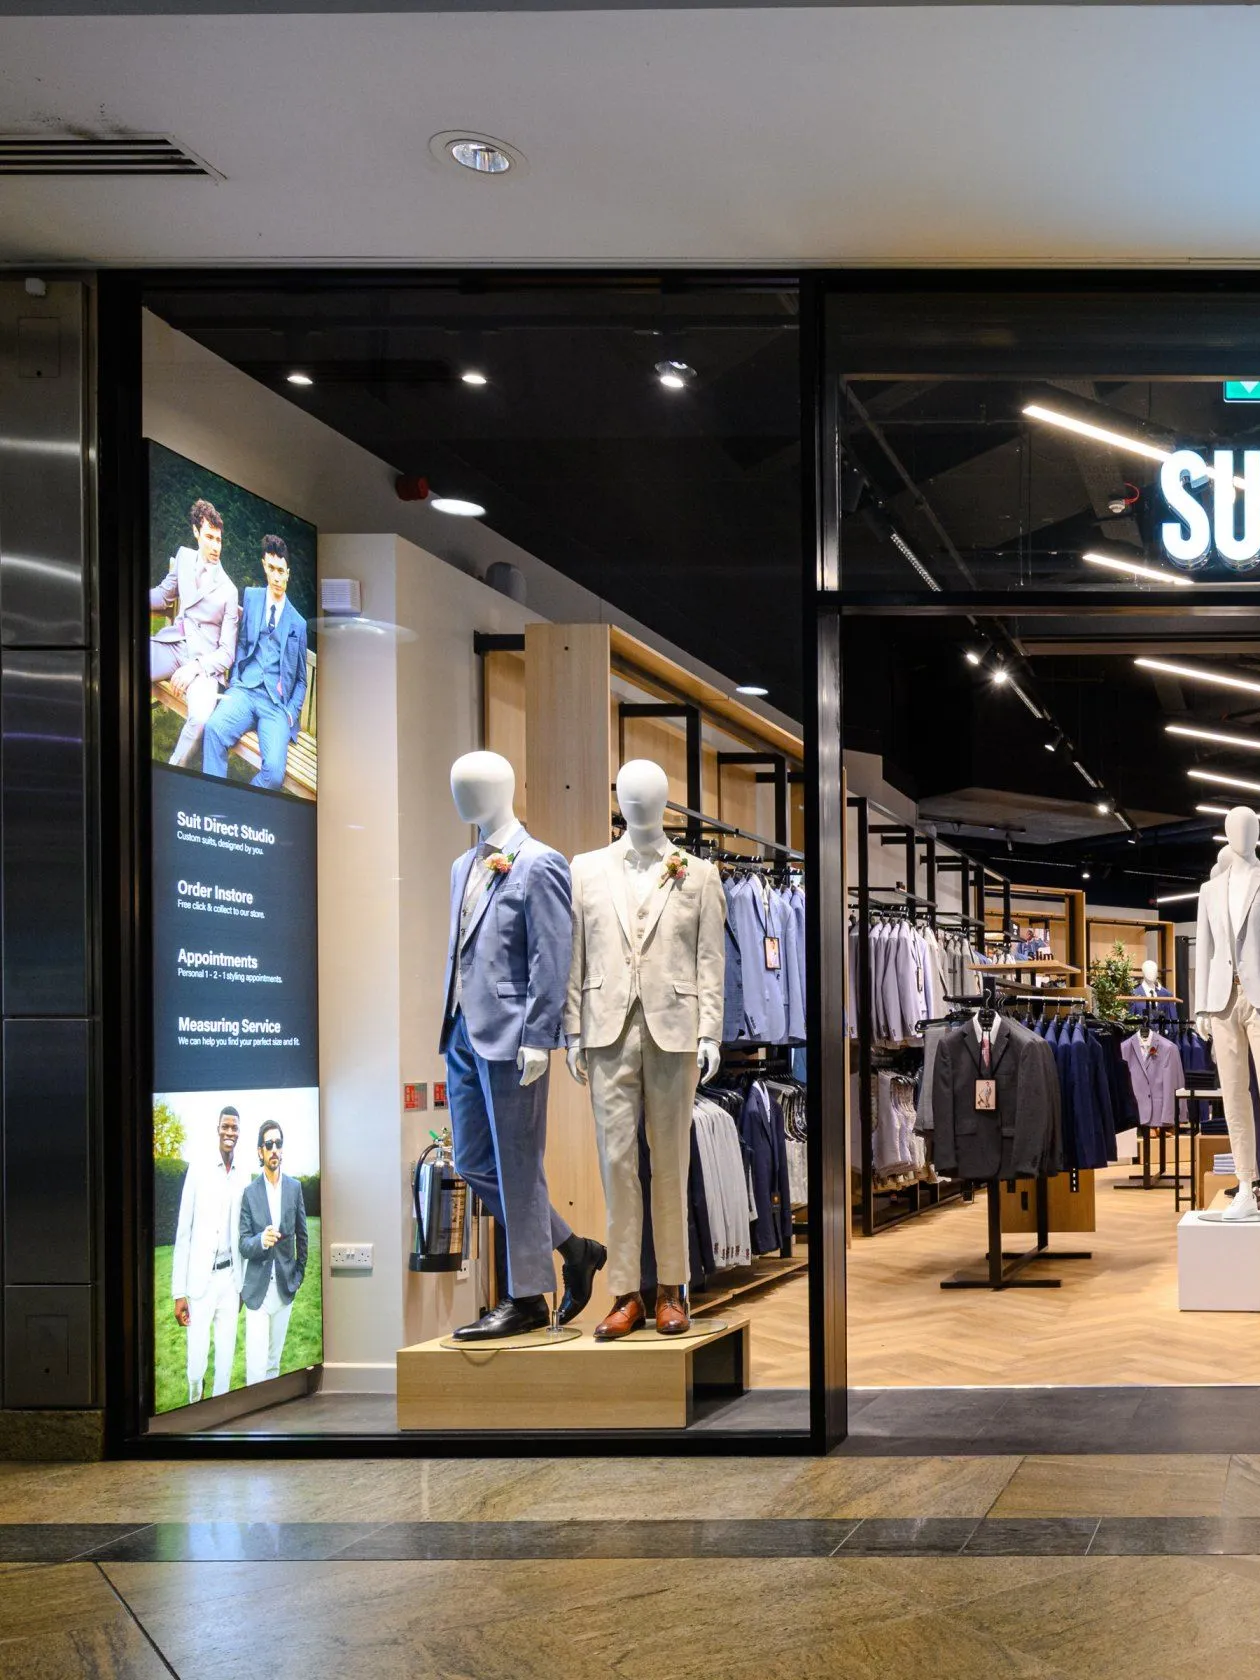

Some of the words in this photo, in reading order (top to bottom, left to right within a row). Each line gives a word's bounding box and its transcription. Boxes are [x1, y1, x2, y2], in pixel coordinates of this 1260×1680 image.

[177, 811, 202, 829] Suit
[203, 816, 239, 838] Direct
[240, 824, 275, 845] Studio
[177, 831, 201, 843] Custom
[201, 836, 218, 848] suits,
[218, 839, 244, 851] designed
[244, 843, 252, 855] by
[251, 847, 264, 856] you.
[177, 879, 212, 899] Order
[214, 884, 254, 905] Instore
[177, 899, 191, 909] Free
[192, 901, 206, 912] click
[206, 903, 213, 912] &
[213, 904, 232, 915] collect
[233, 907, 240, 916] to
[239, 909, 250, 917] our
[177, 948, 258, 969] Appointments
[177, 968, 205, 978] Personal
[226, 972, 245, 983] styling
[246, 973, 283, 984] appointments.
[178, 1016, 240, 1036] Measuring
[241, 1018, 281, 1034] Service
[178, 1036, 189, 1046] We
[189, 1038, 201, 1046] can
[202, 1037, 215, 1047] help
[215, 1038, 227, 1047] you
[227, 1037, 239, 1046] find
[239, 1038, 253, 1048] your
[252, 1037, 272, 1047] perfect
[272, 1037, 282, 1046] size
[282, 1037, 294, 1046] and
